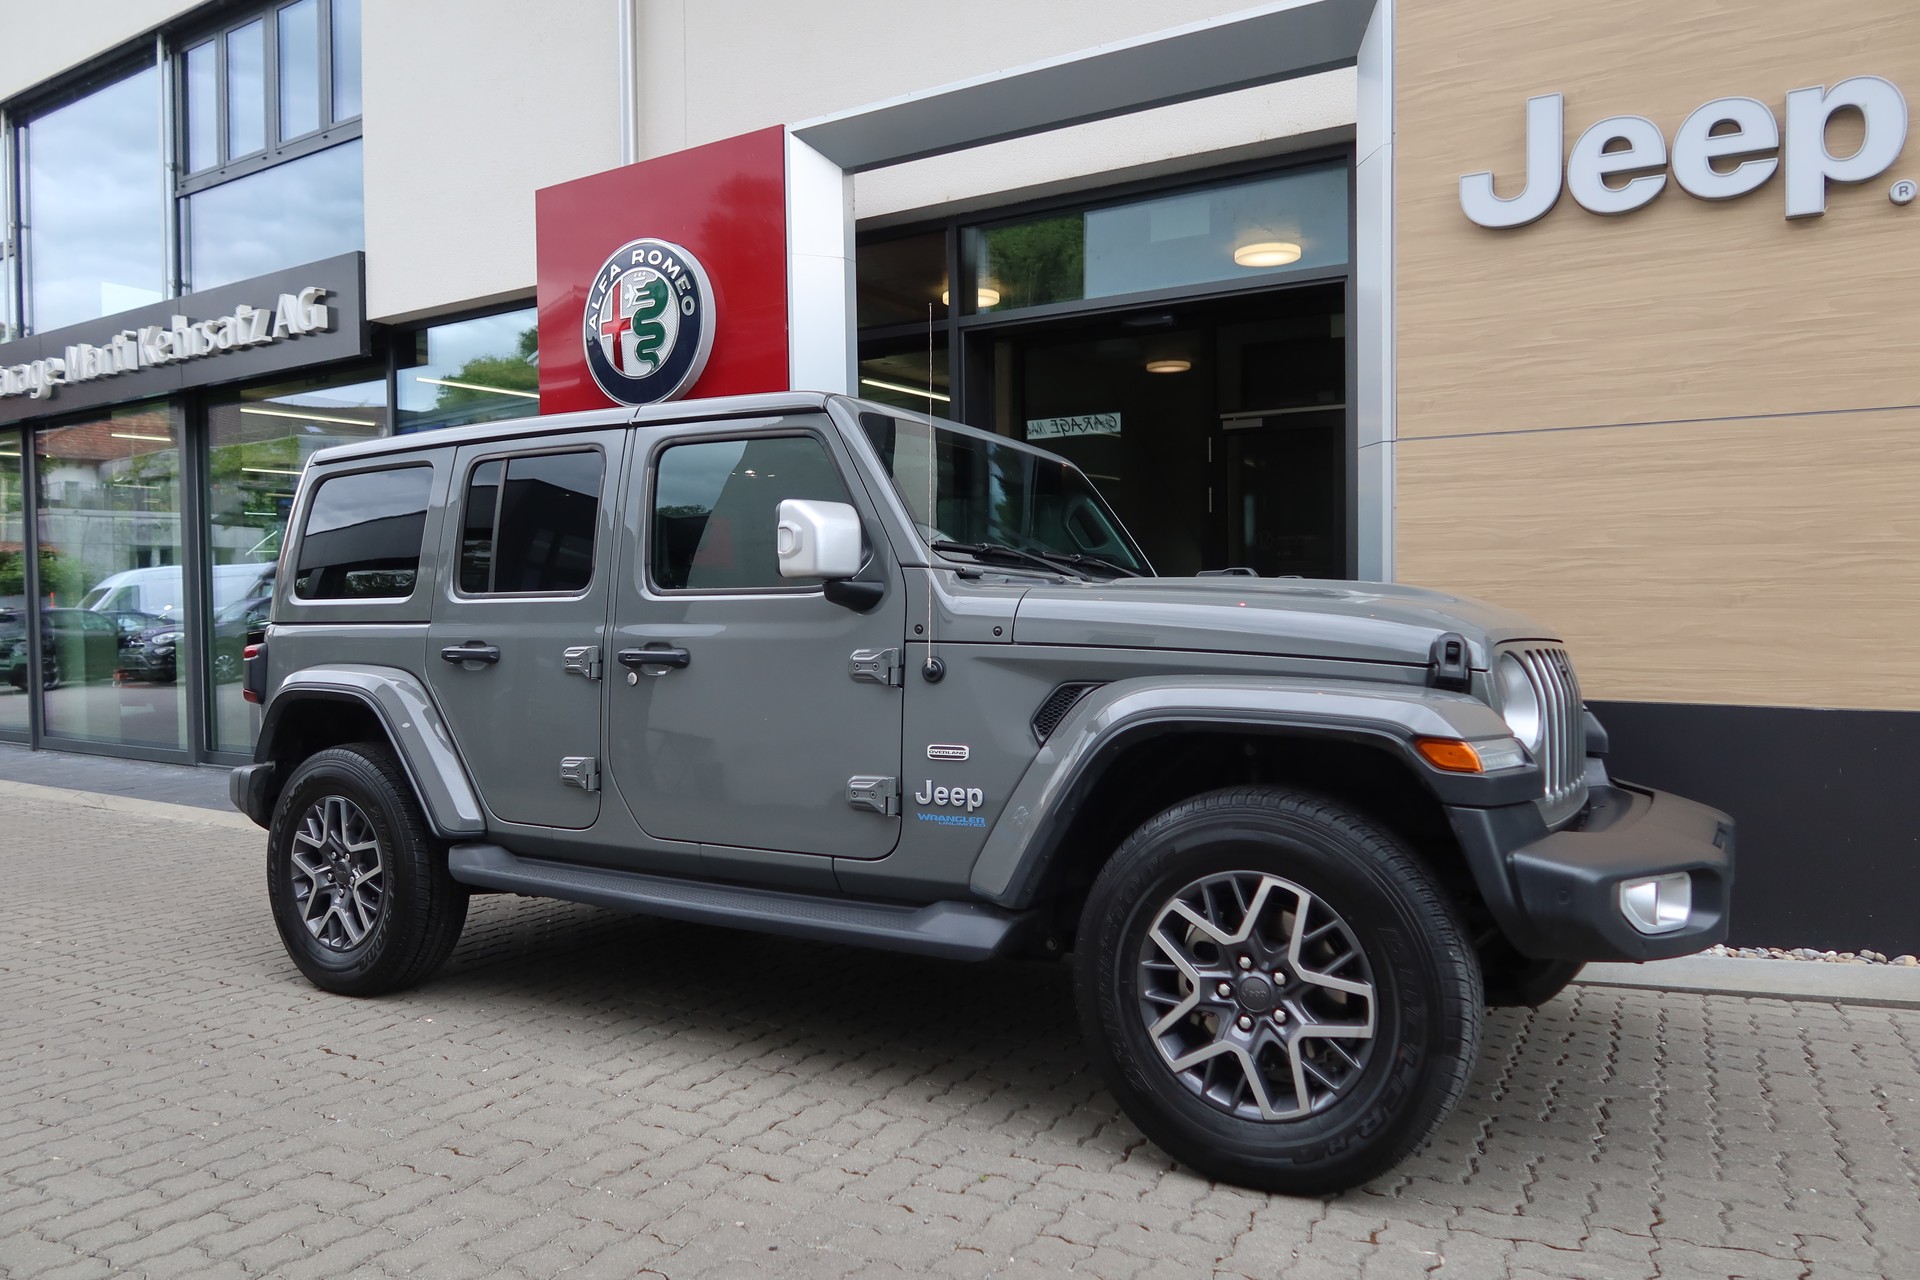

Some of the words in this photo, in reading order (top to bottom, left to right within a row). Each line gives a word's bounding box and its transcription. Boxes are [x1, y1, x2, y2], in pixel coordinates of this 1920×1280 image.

[1459, 75, 1908, 229] Jeep
[588, 264, 622, 332] ALFA
[631, 249, 696, 316] ROMEO
[0, 357, 66, 399] arage
[137, 305, 273, 366] Kehrsatz
[272, 286, 328, 338] AG
[915, 779, 984, 812] Jeep
[917, 812, 985, 824] WRANGLER
